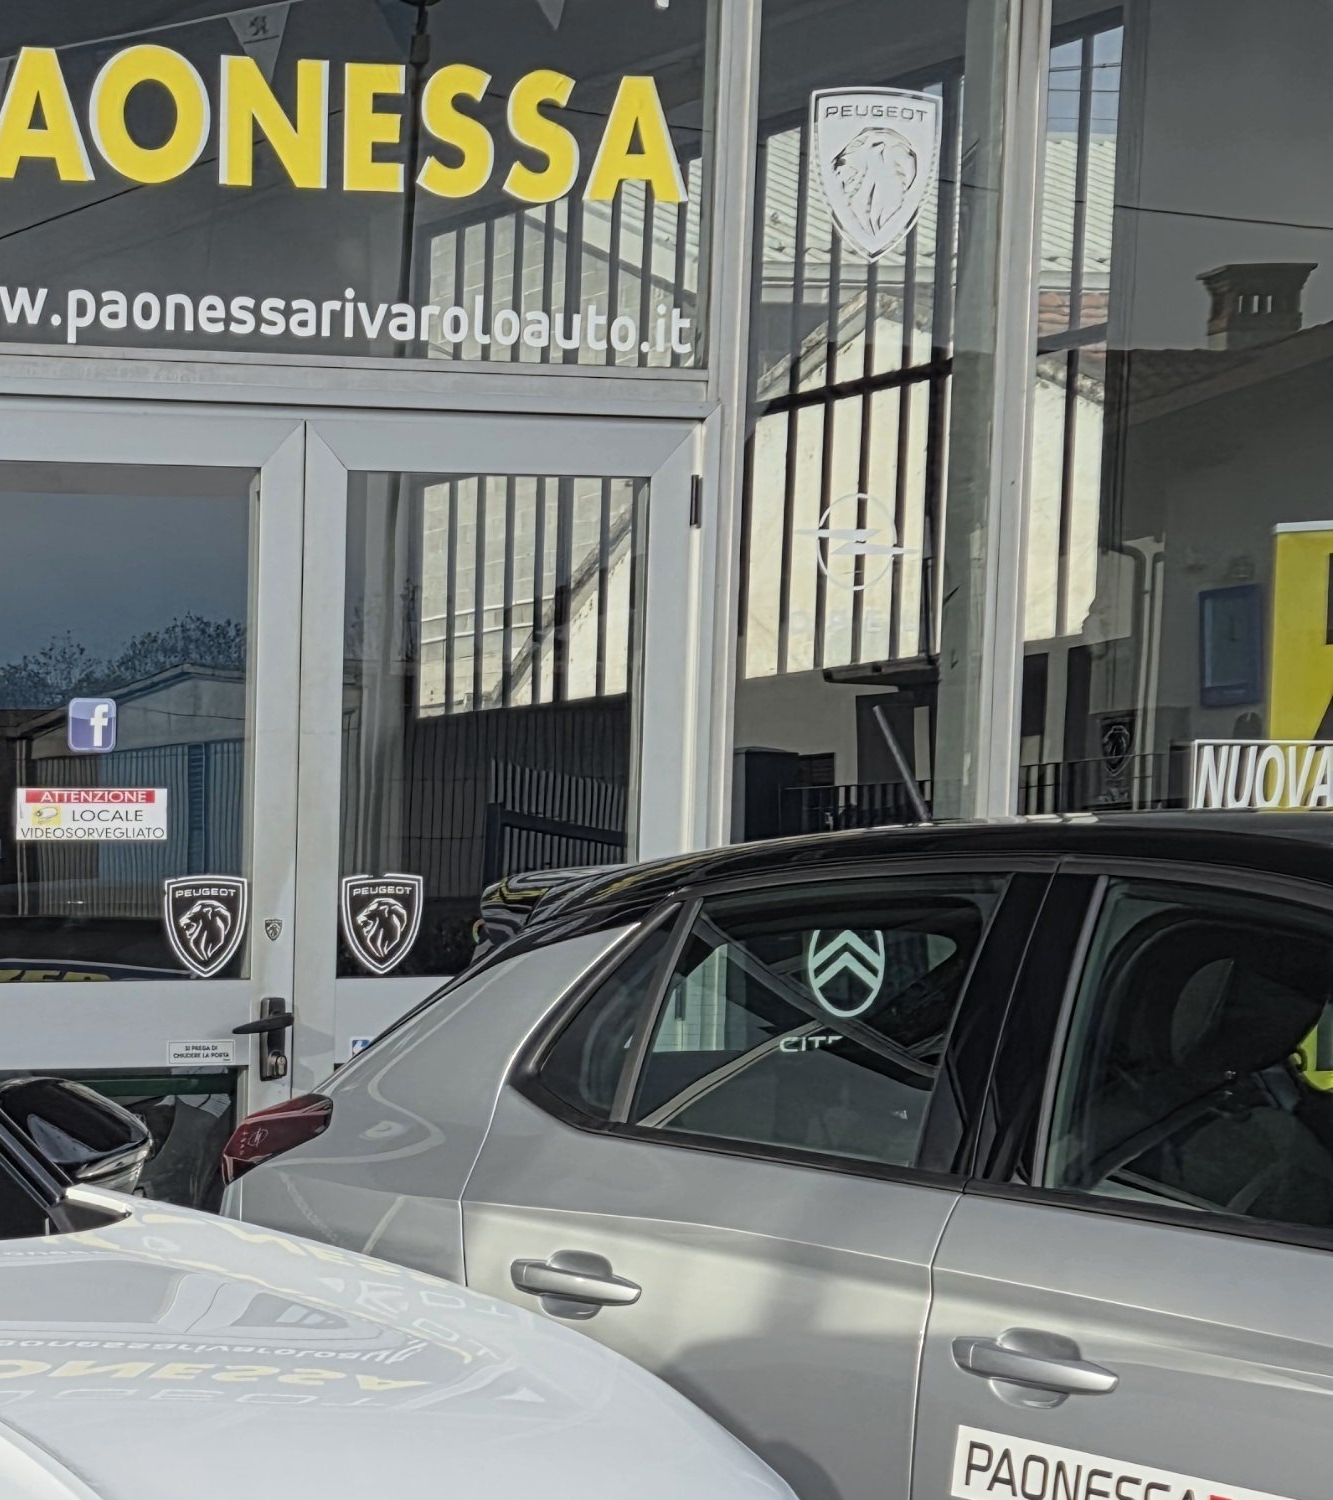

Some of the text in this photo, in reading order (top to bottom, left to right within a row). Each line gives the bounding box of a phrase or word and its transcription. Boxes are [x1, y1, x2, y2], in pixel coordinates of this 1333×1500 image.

[824, 104, 929, 124] PEUGEOT
[1195, 743, 1333, 809] NUOVA
[40, 789, 147, 803] ATTENZIONE
[71, 809, 144, 823] LOCALE
[20, 827, 165, 839] VIDEOSORVEGLIATO
[175, 887, 237, 898] PEUGEOT
[352, 885, 413, 896] PEUGEOT
